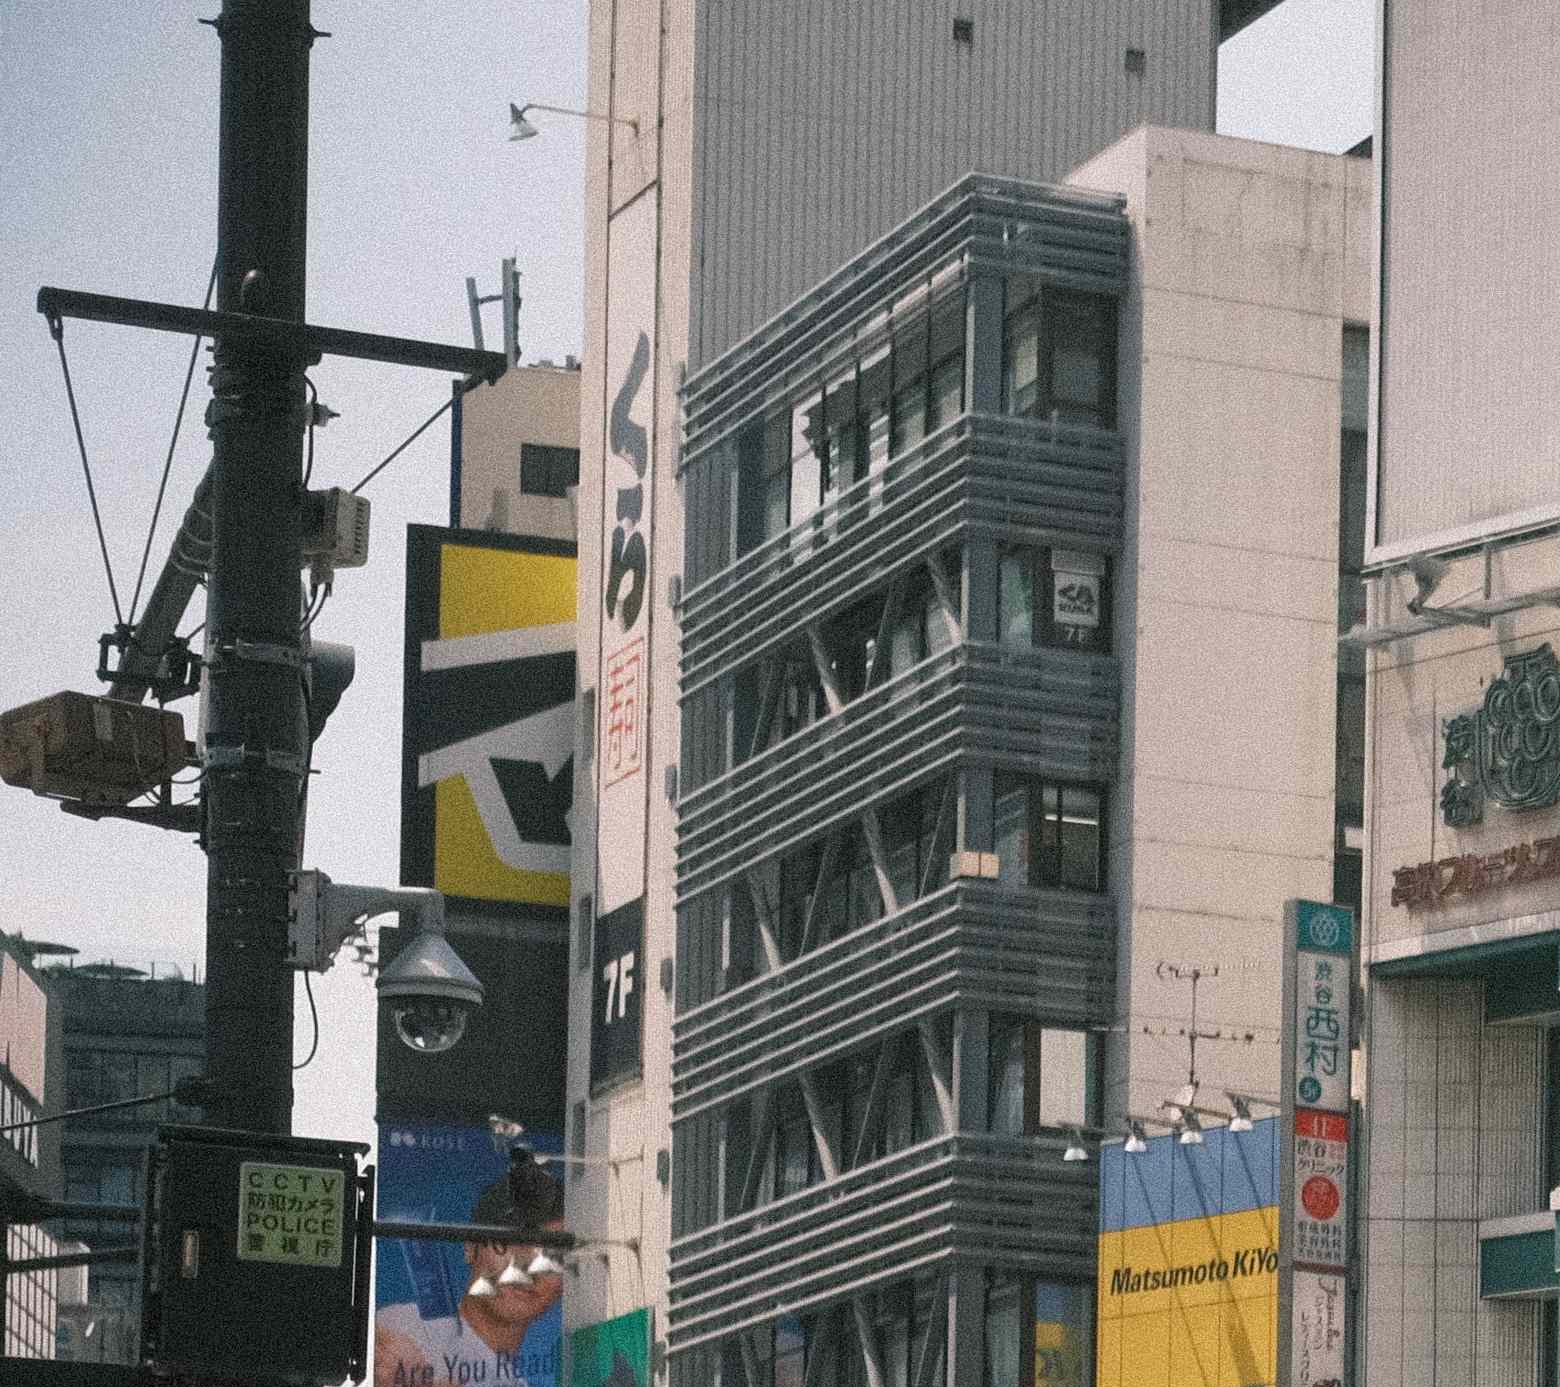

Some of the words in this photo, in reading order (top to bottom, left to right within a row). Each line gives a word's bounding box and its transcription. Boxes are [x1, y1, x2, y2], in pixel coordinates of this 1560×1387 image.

[603, 952, 634, 1023] 7F
[1306, 962, 1340, 1077] 渋谷西村
[249, 1172, 336, 1194] CCTV
[249, 1193, 335, 1214] 防犯カメラ
[247, 1213, 336, 1236] POLICE
[1110, 1254, 1230, 1296] Matsumoto
[1232, 1247, 1279, 1281] KiYo
[444, 1354, 486, 1383] You
